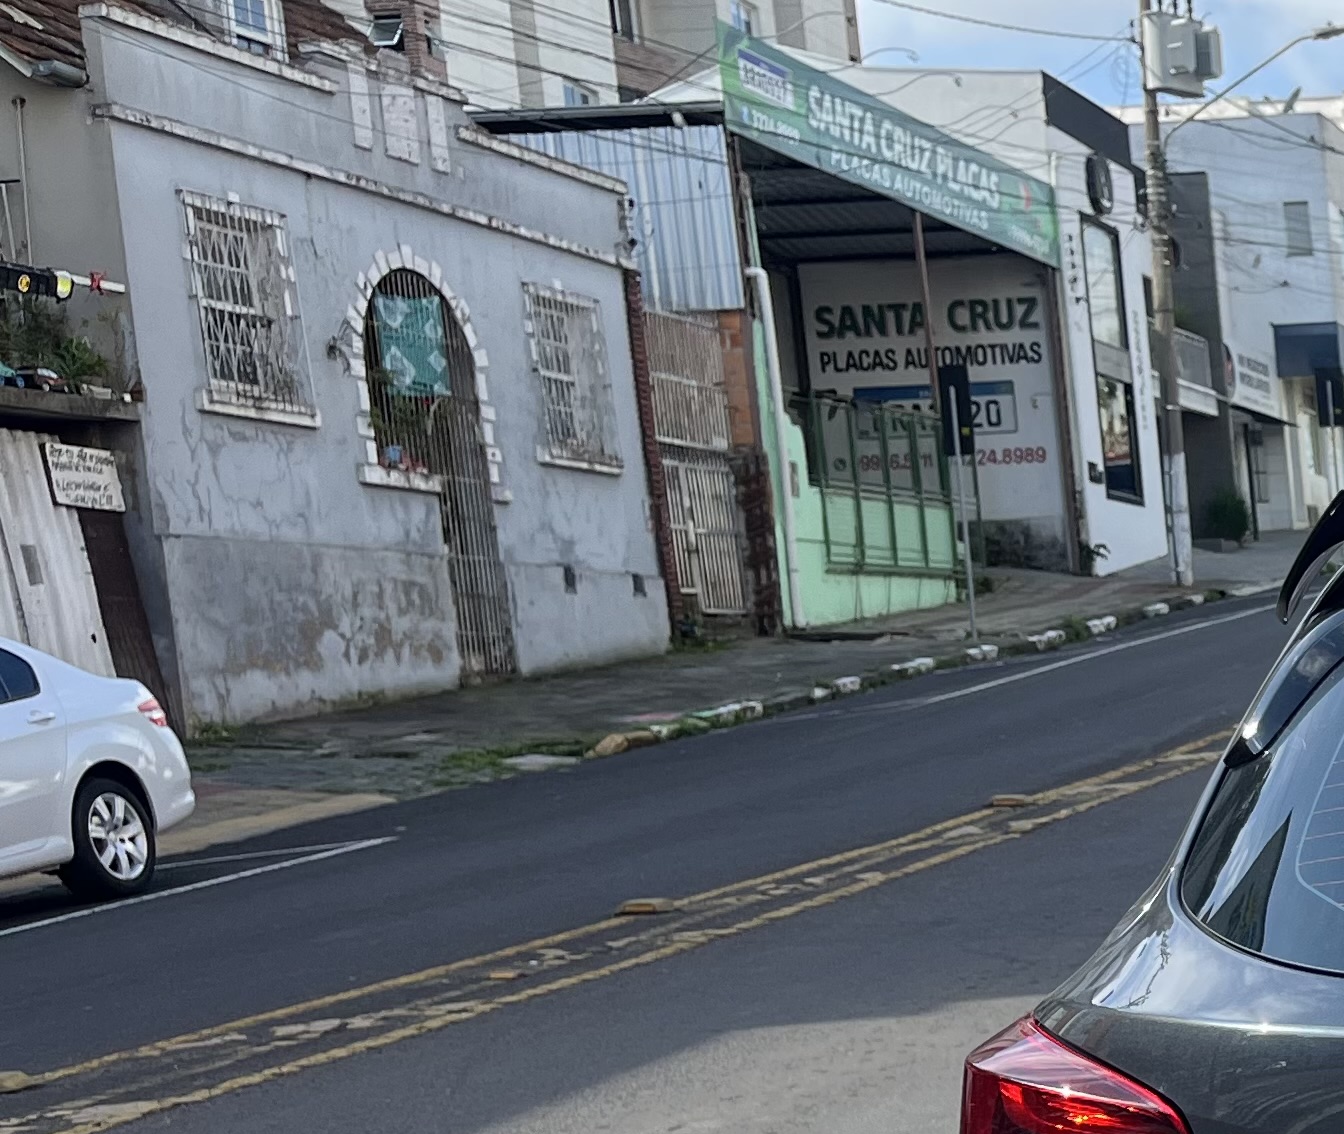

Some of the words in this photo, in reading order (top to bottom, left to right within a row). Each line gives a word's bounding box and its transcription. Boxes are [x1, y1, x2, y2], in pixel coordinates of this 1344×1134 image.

[808, 84, 876, 153] SANTA
[880, 119, 933, 179] CRUZ
[936, 145, 1000, 210] PLACAS
[831, 147, 892, 188] PLACAS
[893, 174, 989, 230] AUTOMOTIVAS
[814, 301, 926, 340] SANTA
[947, 296, 1040, 333] CRUZ
[820, 348, 898, 374] PLACAS
[904, 342, 1043, 370] AUTOMOTIVAS
